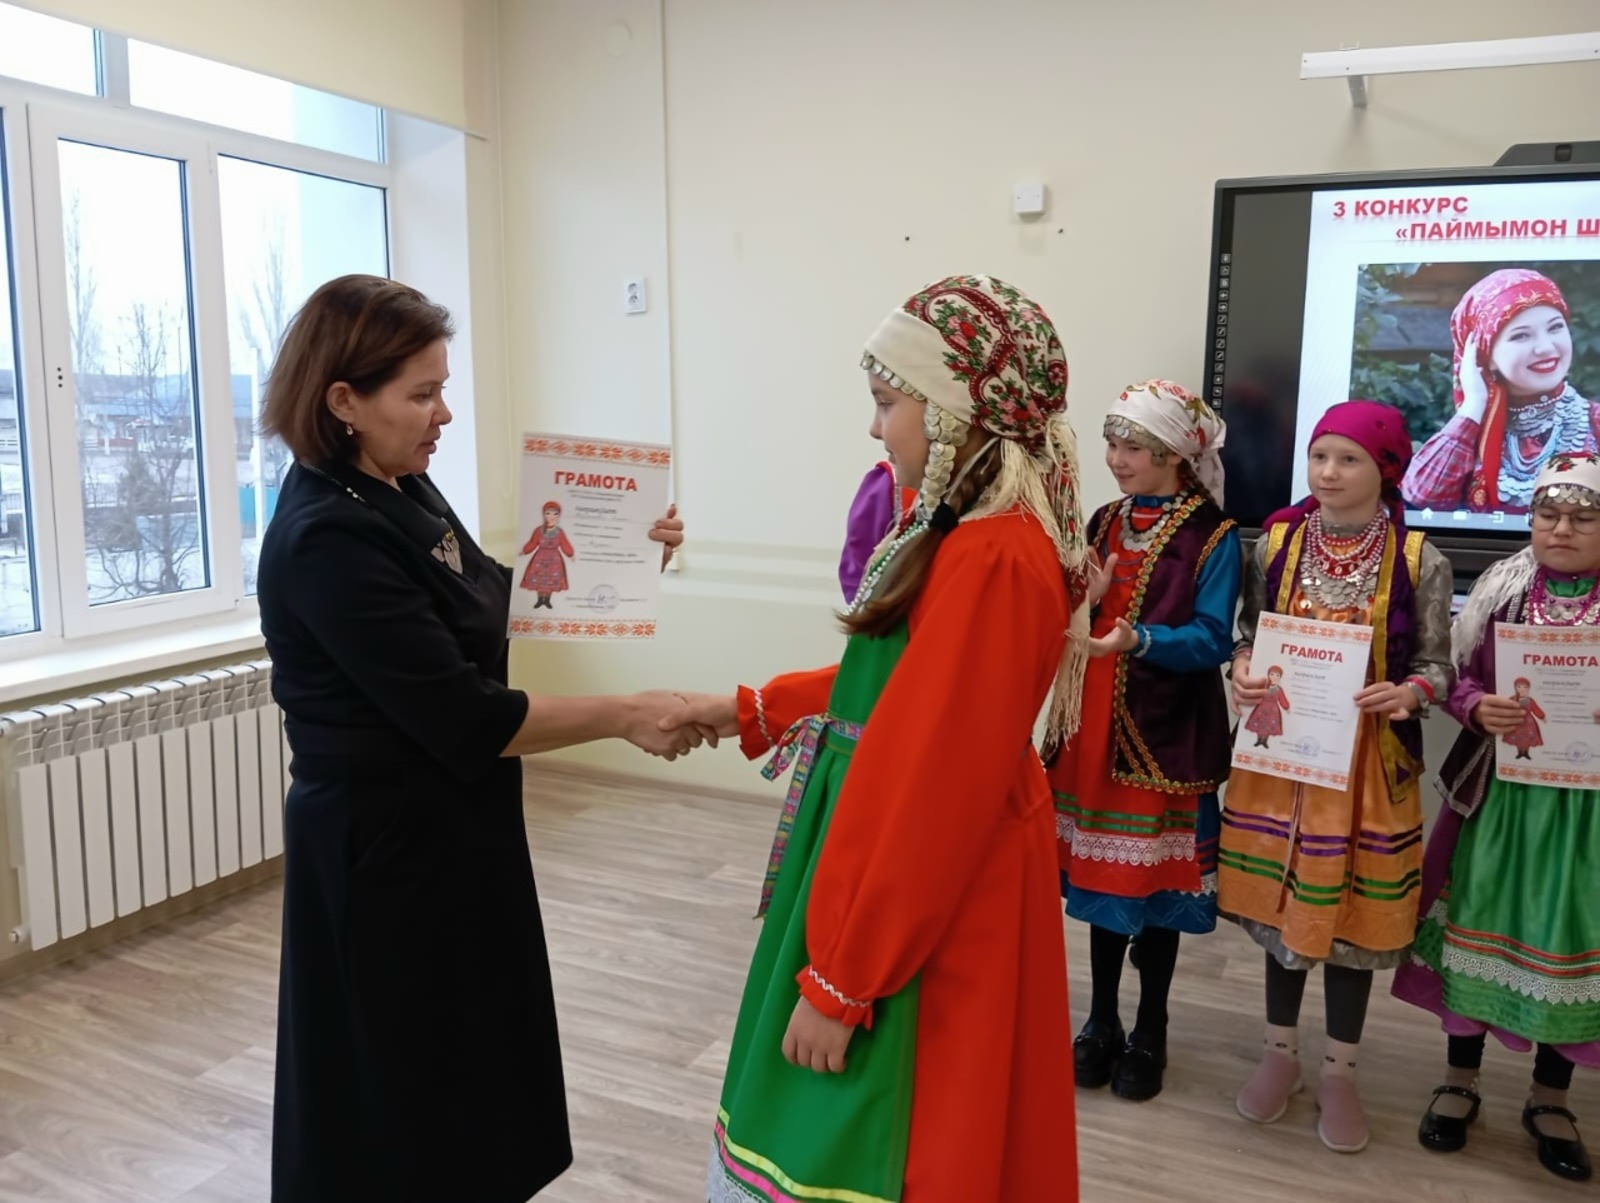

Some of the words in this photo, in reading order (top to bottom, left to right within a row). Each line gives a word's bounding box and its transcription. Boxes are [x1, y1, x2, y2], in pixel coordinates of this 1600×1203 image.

[1354, 196, 1469, 216] КОНКУРС
[1395, 218, 1567, 240] «ПАЙМЫМОН
[554, 471, 638, 491] ГРАМОТА
[1280, 643, 1344, 663] ГРАМОТА
[1523, 654, 1599, 667] ГРАМОТА
